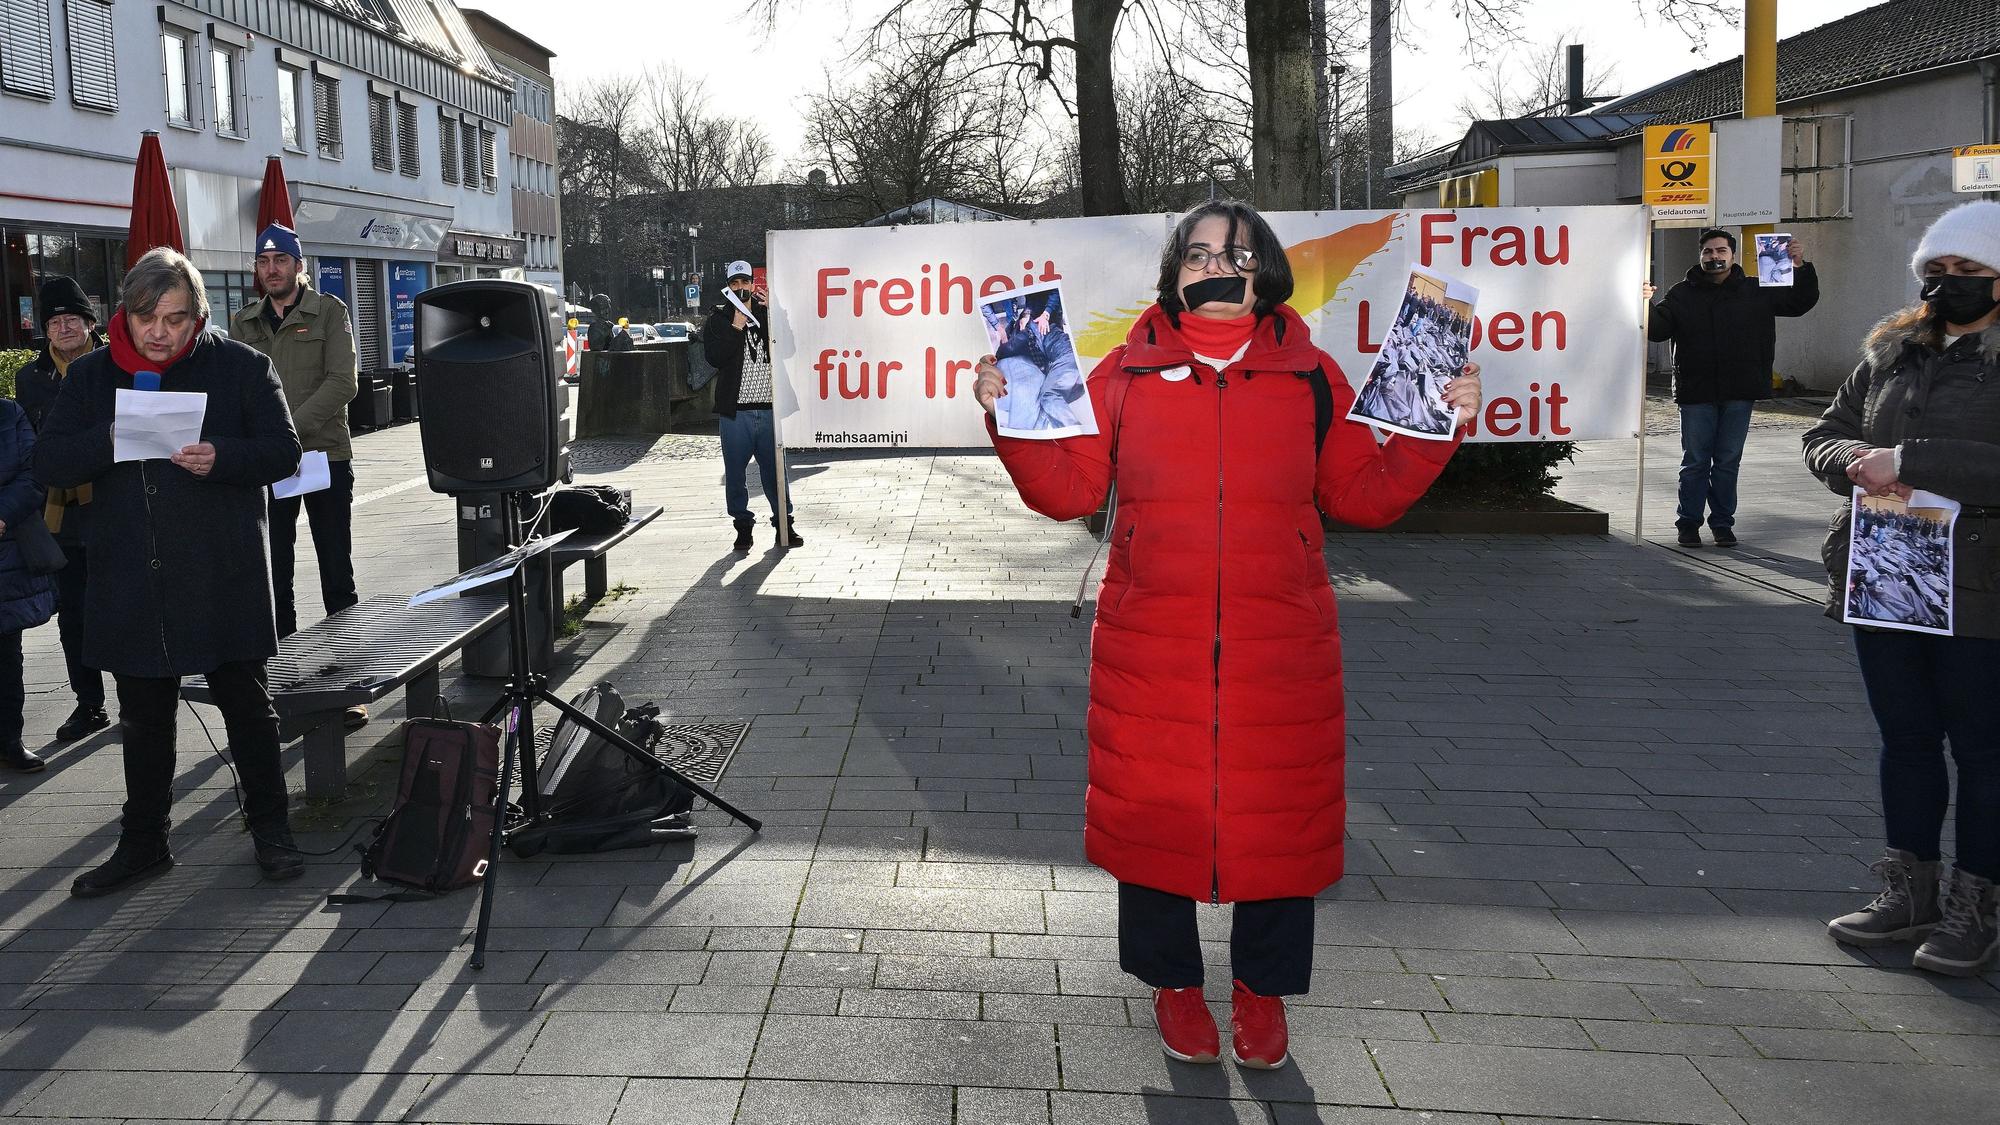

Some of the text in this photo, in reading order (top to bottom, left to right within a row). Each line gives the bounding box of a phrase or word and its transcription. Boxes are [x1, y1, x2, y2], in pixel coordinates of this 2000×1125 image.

[1973, 147, 2000, 155] Postban
[1961, 183, 2000, 191] Geldautoma
[1660, 193, 1696, 202] DHL
[1657, 208, 1706, 216] Geldautomat
[1421, 213, 1570, 267] Frau
[457, 240, 475, 257] BARBER
[476, 242, 487, 258] SHOP
[688, 287, 697, 298] P
[813, 346, 982, 400] für Ir
[815, 431, 909, 443] #mahsaamini
